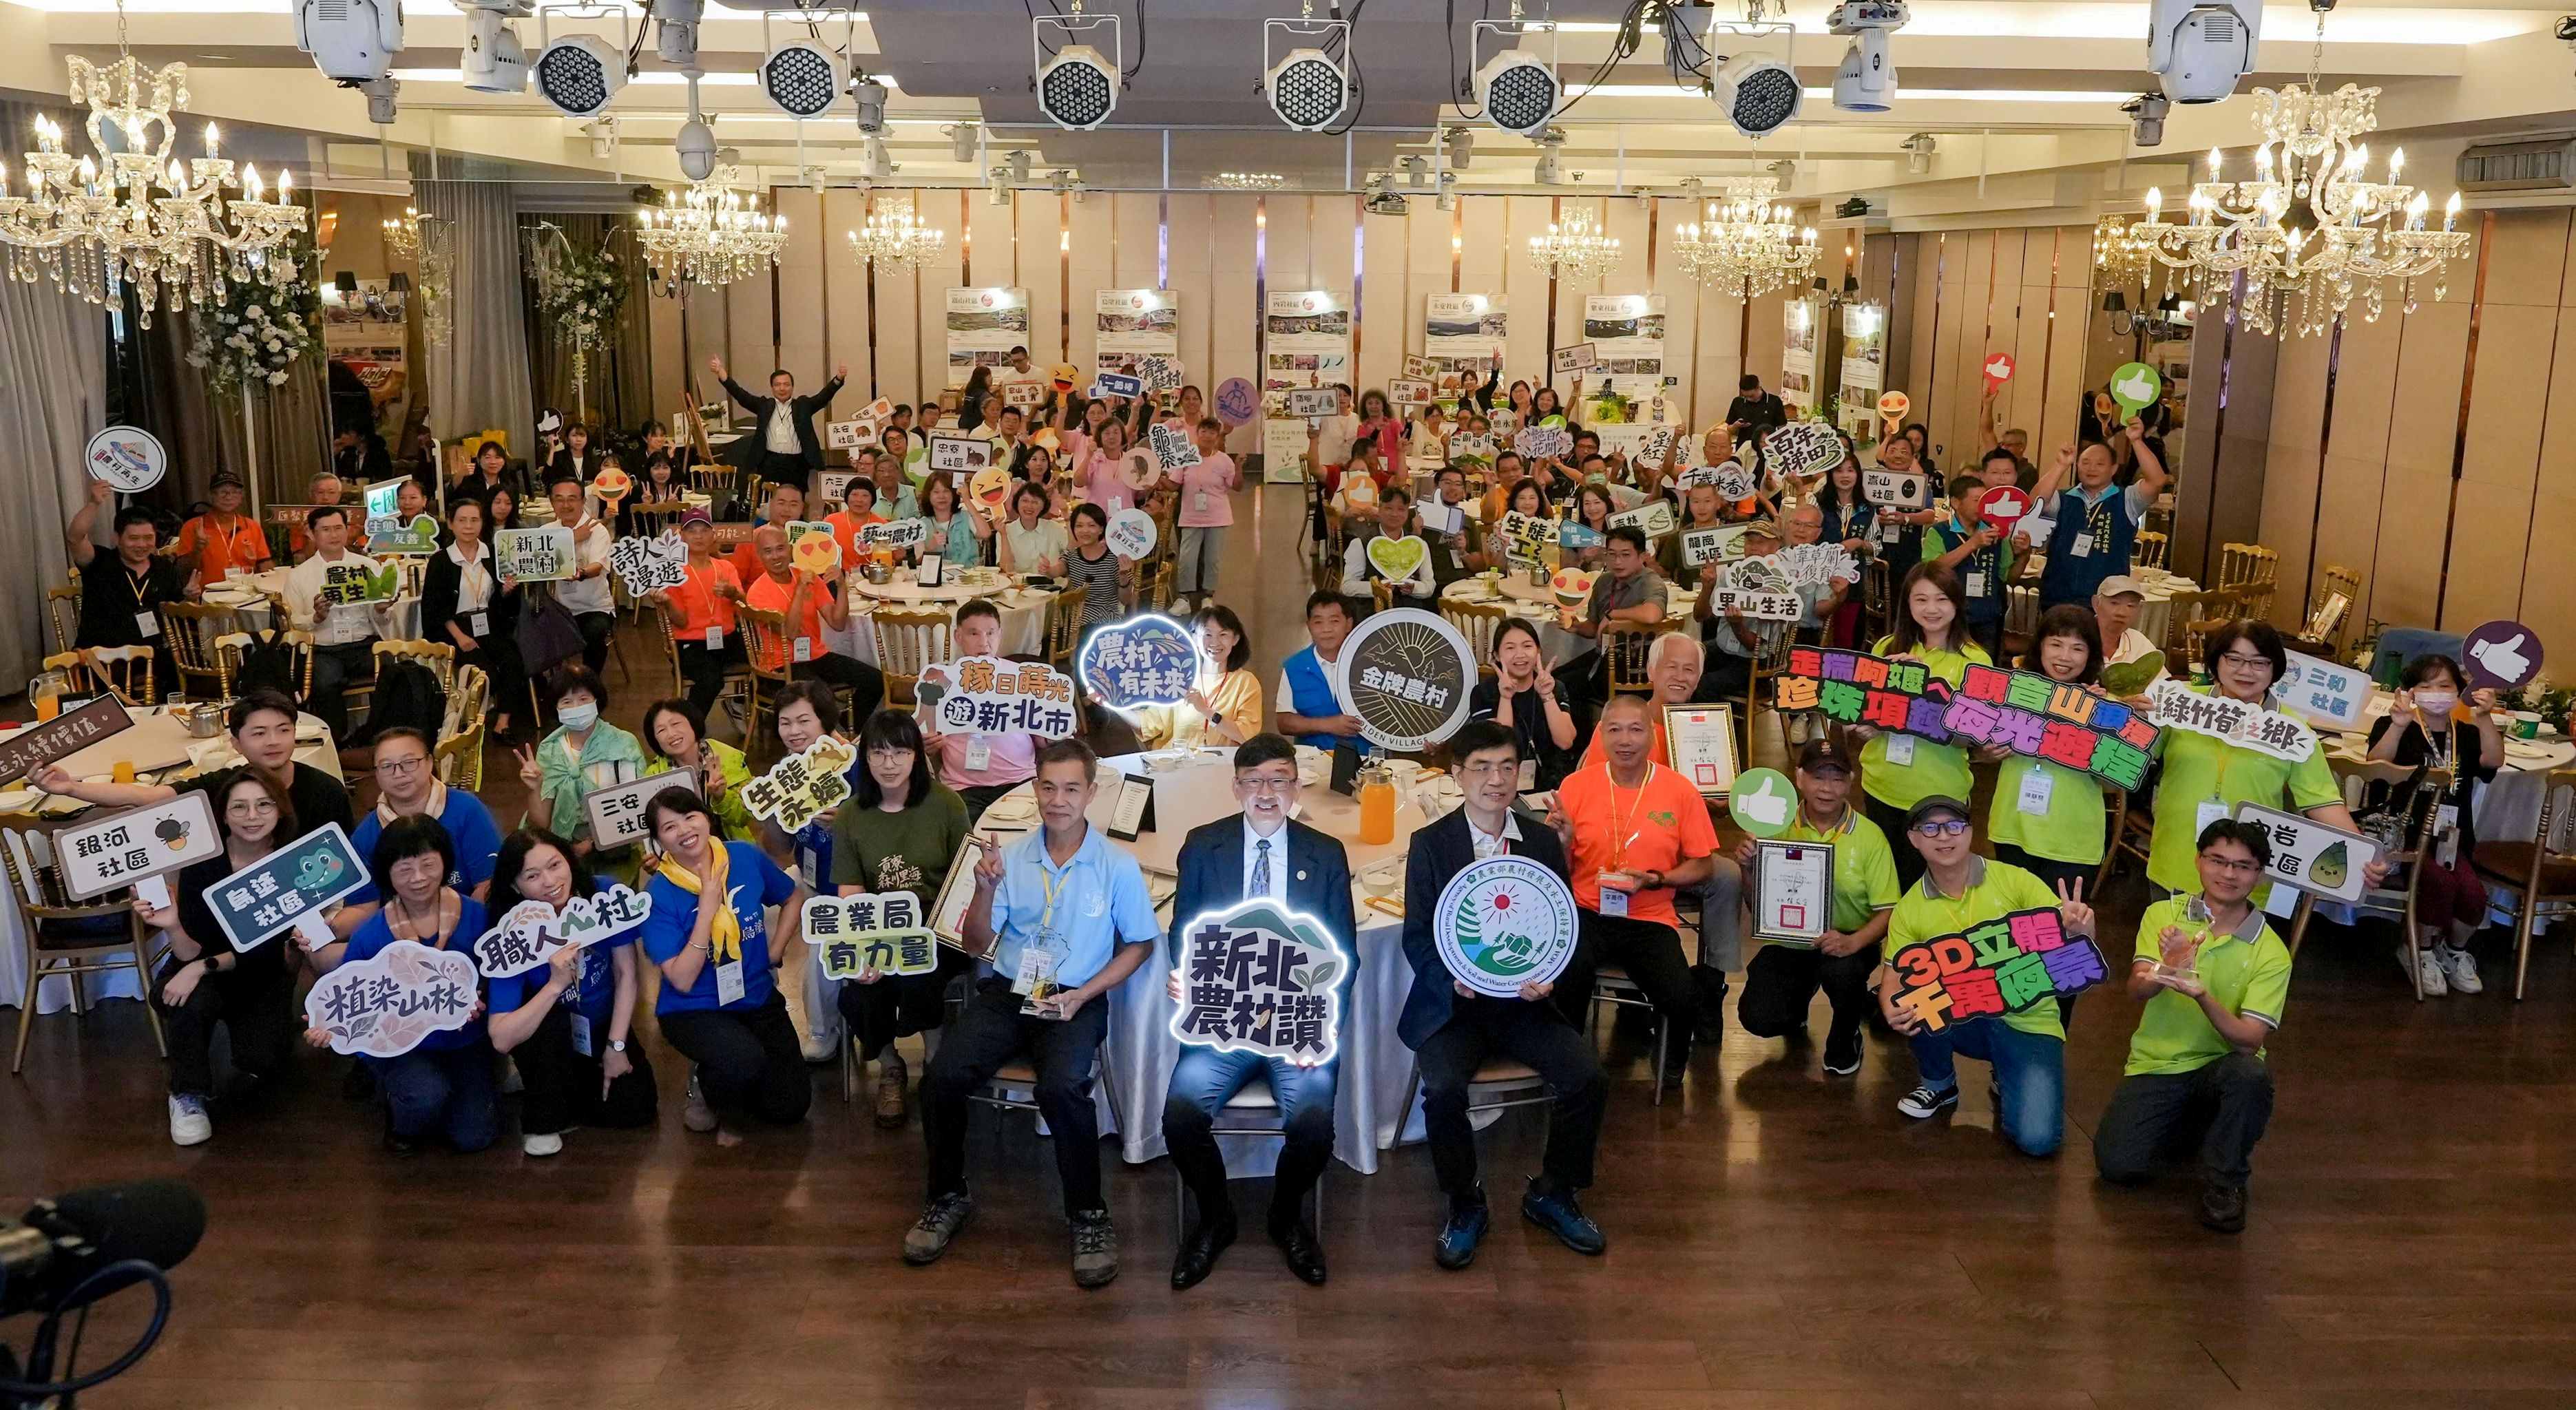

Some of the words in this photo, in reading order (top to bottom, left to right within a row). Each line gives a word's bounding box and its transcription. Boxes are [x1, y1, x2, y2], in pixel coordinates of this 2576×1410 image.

[1301, 405, 1317, 413] 社區
[833, 425, 849, 436] 永安
[838, 435, 855, 444] 社區
[1769, 425, 1816, 452] 百年
[943, 458, 963, 468] 社區
[1779, 445, 1828, 474] 梯田
[826, 478, 844, 486] 六三
[1682, 468, 1746, 495] 千歲米香
[1867, 474, 1890, 486] 嵩山
[1872, 490, 1894, 501] 社區
[368, 520, 395, 534] 生態
[393, 533, 419, 545] 友善
[863, 524, 923, 543] 藝術農村
[1505, 515, 1547, 541] 生態
[515, 535, 554, 553] 新北
[611, 540, 664, 570] 詩人
[1688, 534, 1715, 549] 龍崗
[1695, 546, 1723, 561] 社區
[326, 565, 367, 585] 農村
[517, 556, 556, 575] 農村
[627, 561, 687, 595] 漫遊
[322, 585, 366, 604] 再生
[1717, 592, 1799, 616] 里山生活
[1096, 632, 1153, 670] 農村
[959, 660, 1070, 703] 稼日蒔光
[1119, 669, 1188, 699] 有未來
[1359, 666, 1449, 710] 金牌農村
[2307, 666, 2347, 693] 三和
[944, 697, 1072, 737] 遊新北市
[2310, 692, 2349, 717] 社區
[2162, 693, 2301, 750] 綠竹筍之鄉
[1943, 694, 2151, 790] 夜光遊程
[748, 759, 811, 814] 生態
[782, 770, 846, 825] 永續
[601, 793, 640, 817] 三安
[75, 825, 132, 858] 銀河
[97, 846, 150, 878] 社區
[225, 871, 279, 914] 烏塗
[253, 887, 306, 928] 社區
[810, 900, 914, 936] 農業局
[828, 936, 929, 971] 有力量
[1190, 924, 1308, 992] 新北
[1897, 912, 2065, 987] 3D立體
[324, 974, 468, 1023] 植染山林
[1897, 939, 2105, 1032] 千萬夜景
[1181, 983, 1328, 1055] 農村讚
